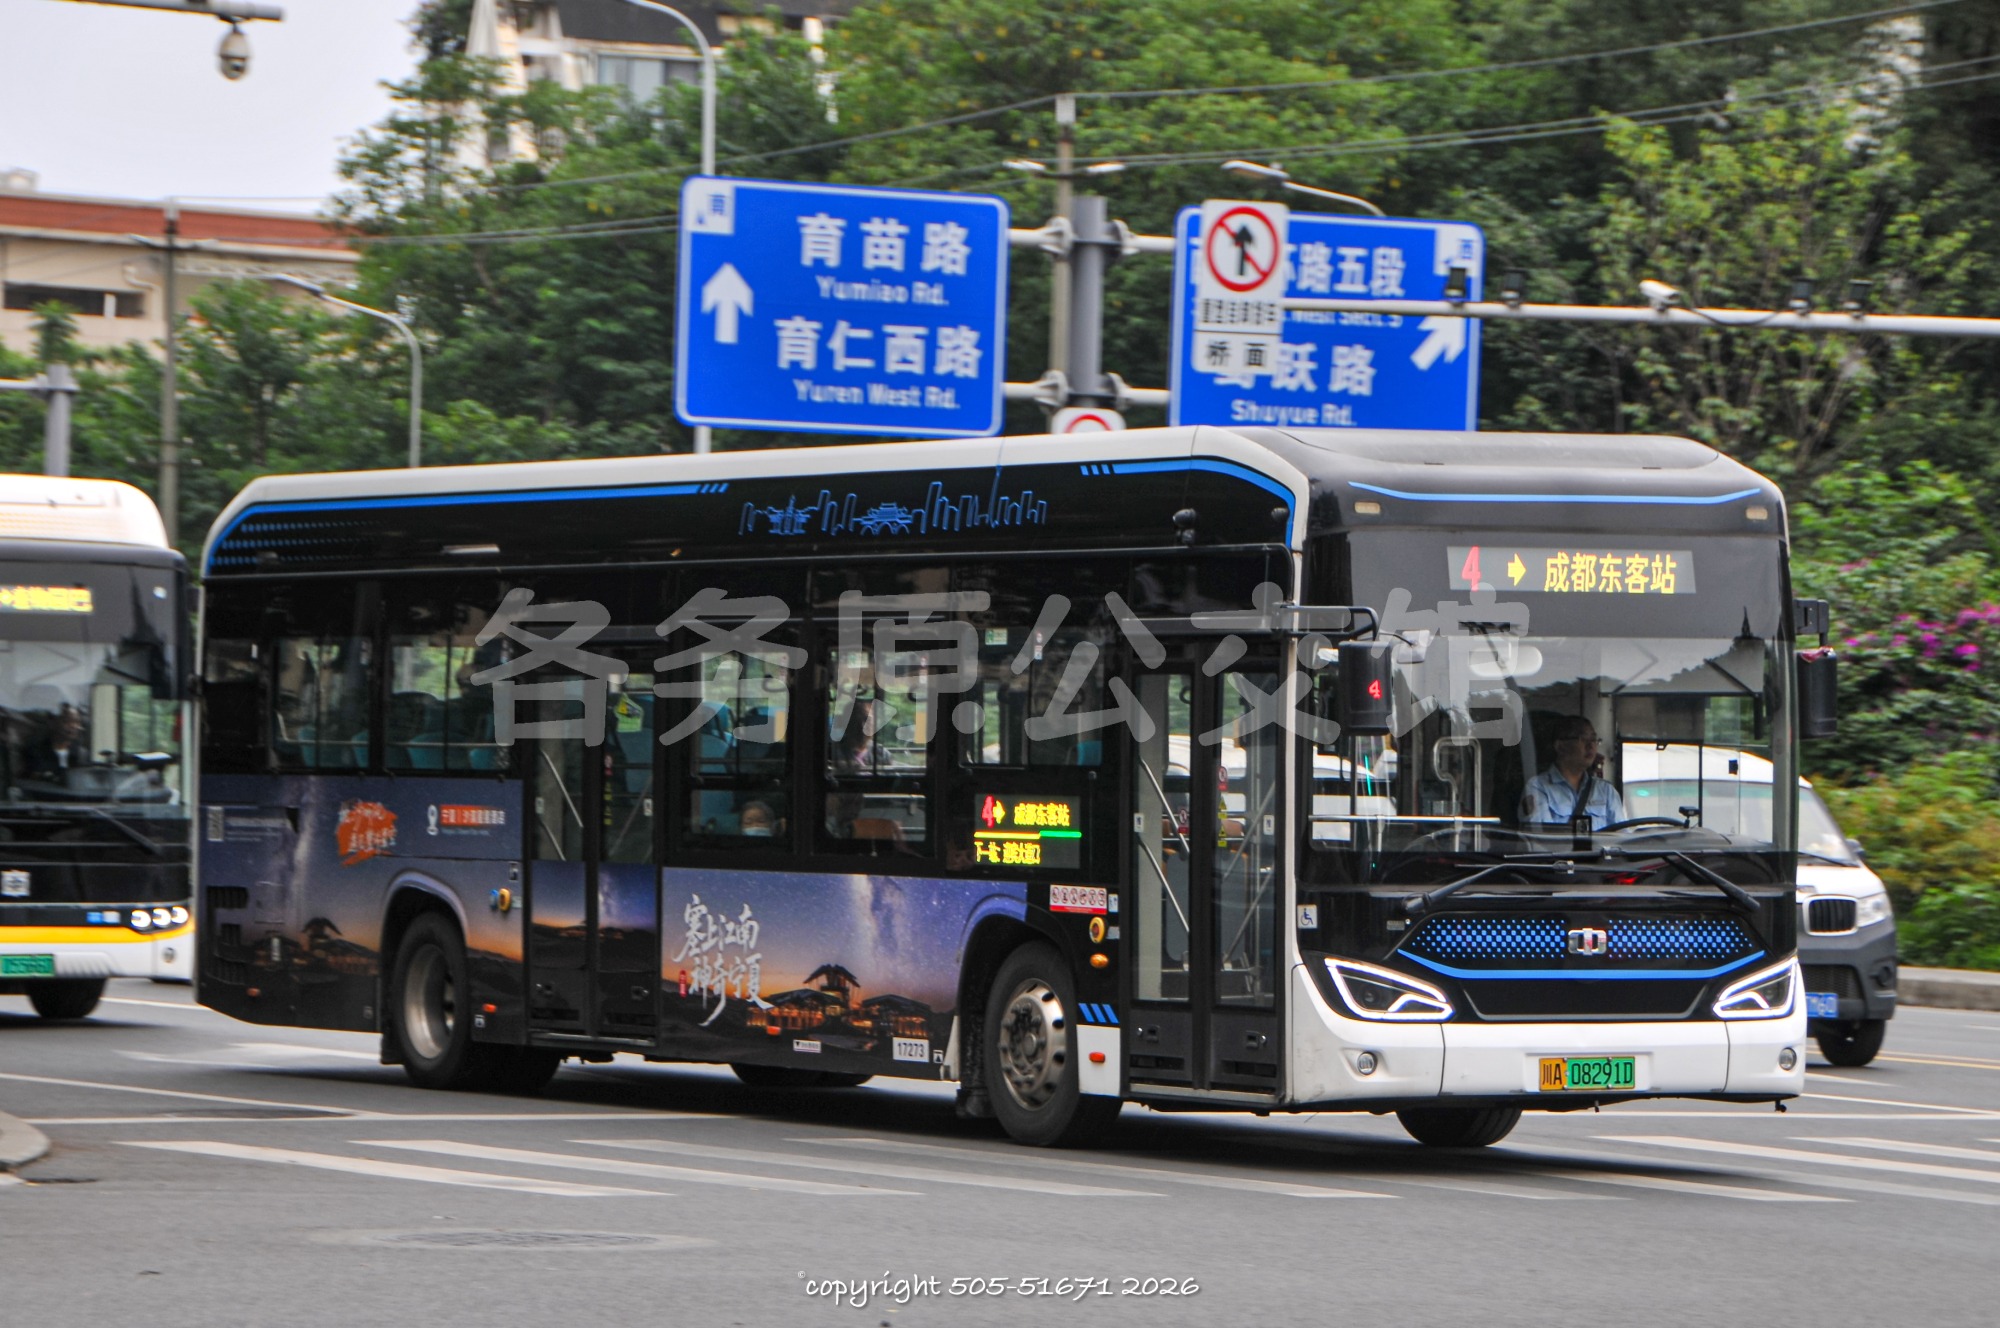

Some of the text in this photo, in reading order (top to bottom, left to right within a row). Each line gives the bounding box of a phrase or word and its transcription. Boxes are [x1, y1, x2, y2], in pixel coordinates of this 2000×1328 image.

[797, 213, 972, 276] 育苗路
[815, 275, 949, 305] Yumiao Rd.
[773, 316, 983, 378] 育仁西路
[793, 379, 960, 409] Yuren West Rd.
[1231, 399, 1357, 427] Shuyue Rd.
[1461, 546, 1481, 591] 4
[1543, 550, 1677, 594] 成都东客站
[1367, 679, 1382, 699] 4
[981, 795, 995, 828] 4
[897, 1042, 925, 1058] 17273
[1542, 1061, 1633, 1086] 川A08291D
